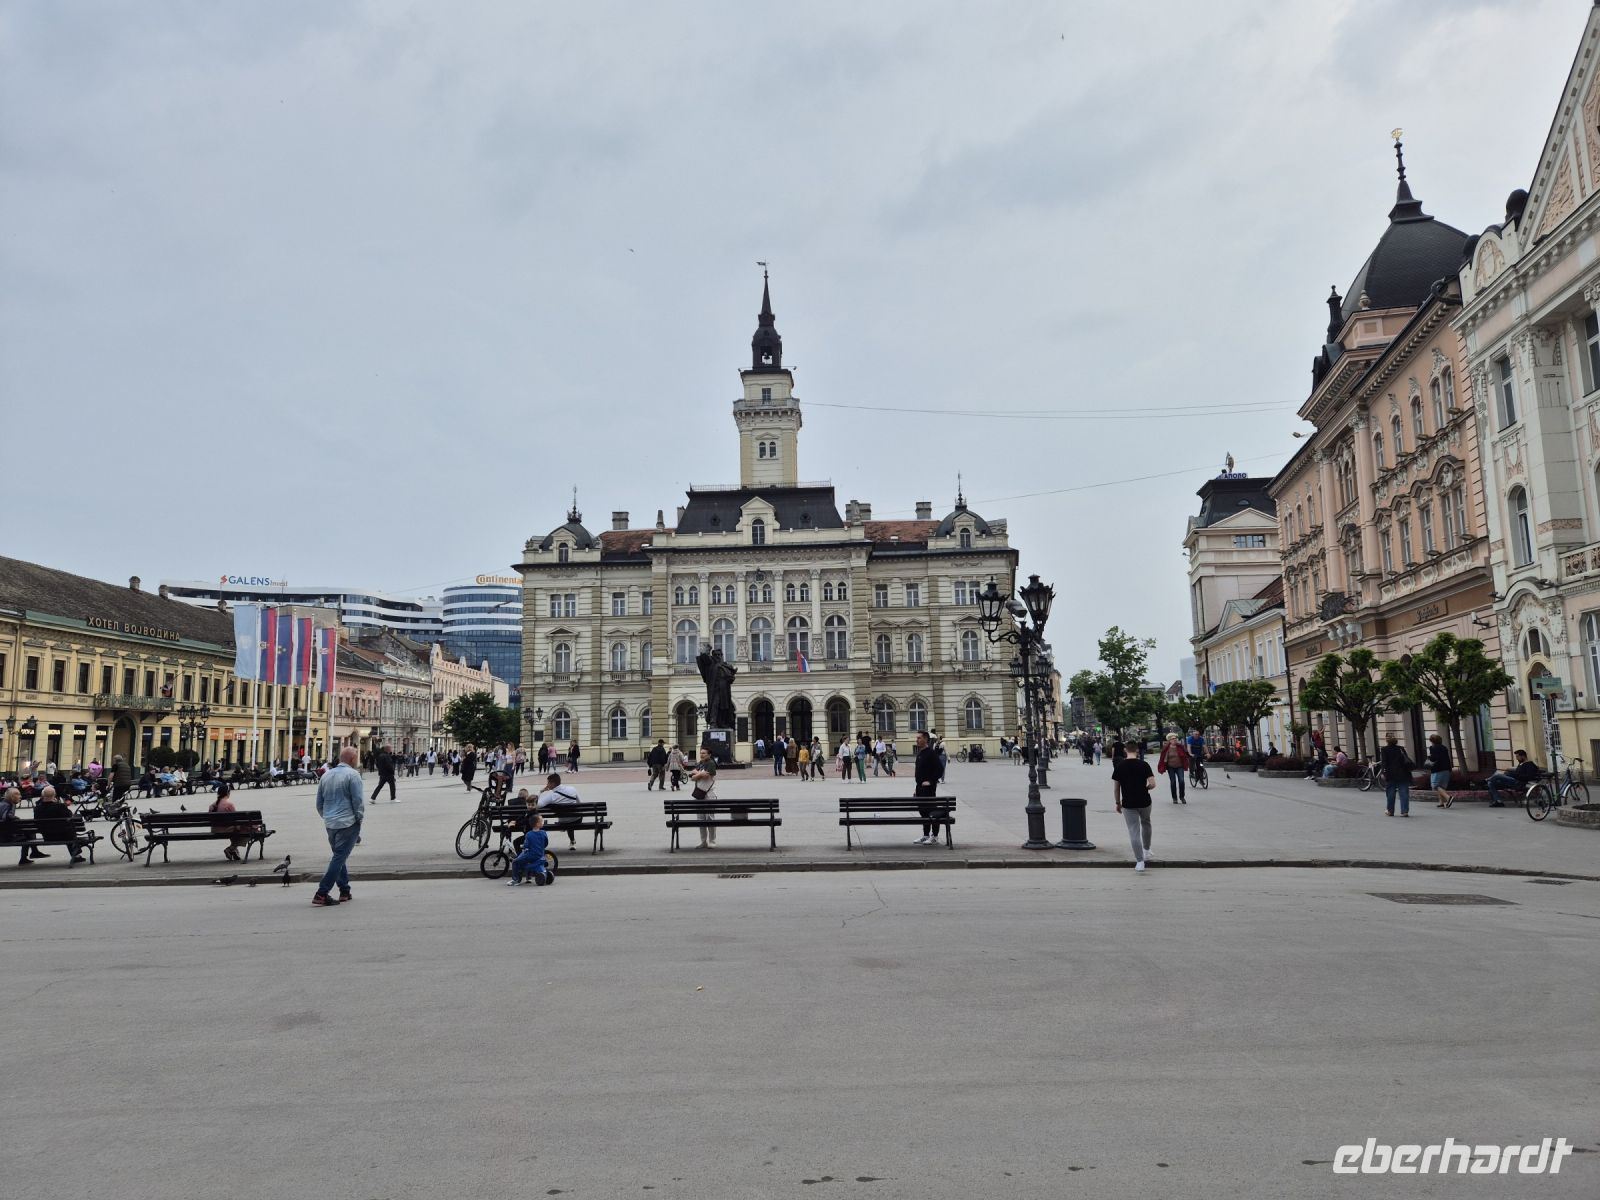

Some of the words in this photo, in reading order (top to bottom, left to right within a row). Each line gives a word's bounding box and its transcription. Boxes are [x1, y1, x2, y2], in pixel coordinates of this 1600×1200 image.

[228, 575, 270, 586] GALENS
[475, 574, 524, 585] Continenta
[88, 616, 119, 631] ХОТЕЛ
[124, 623, 180, 641] ВОЈВОДИНА
